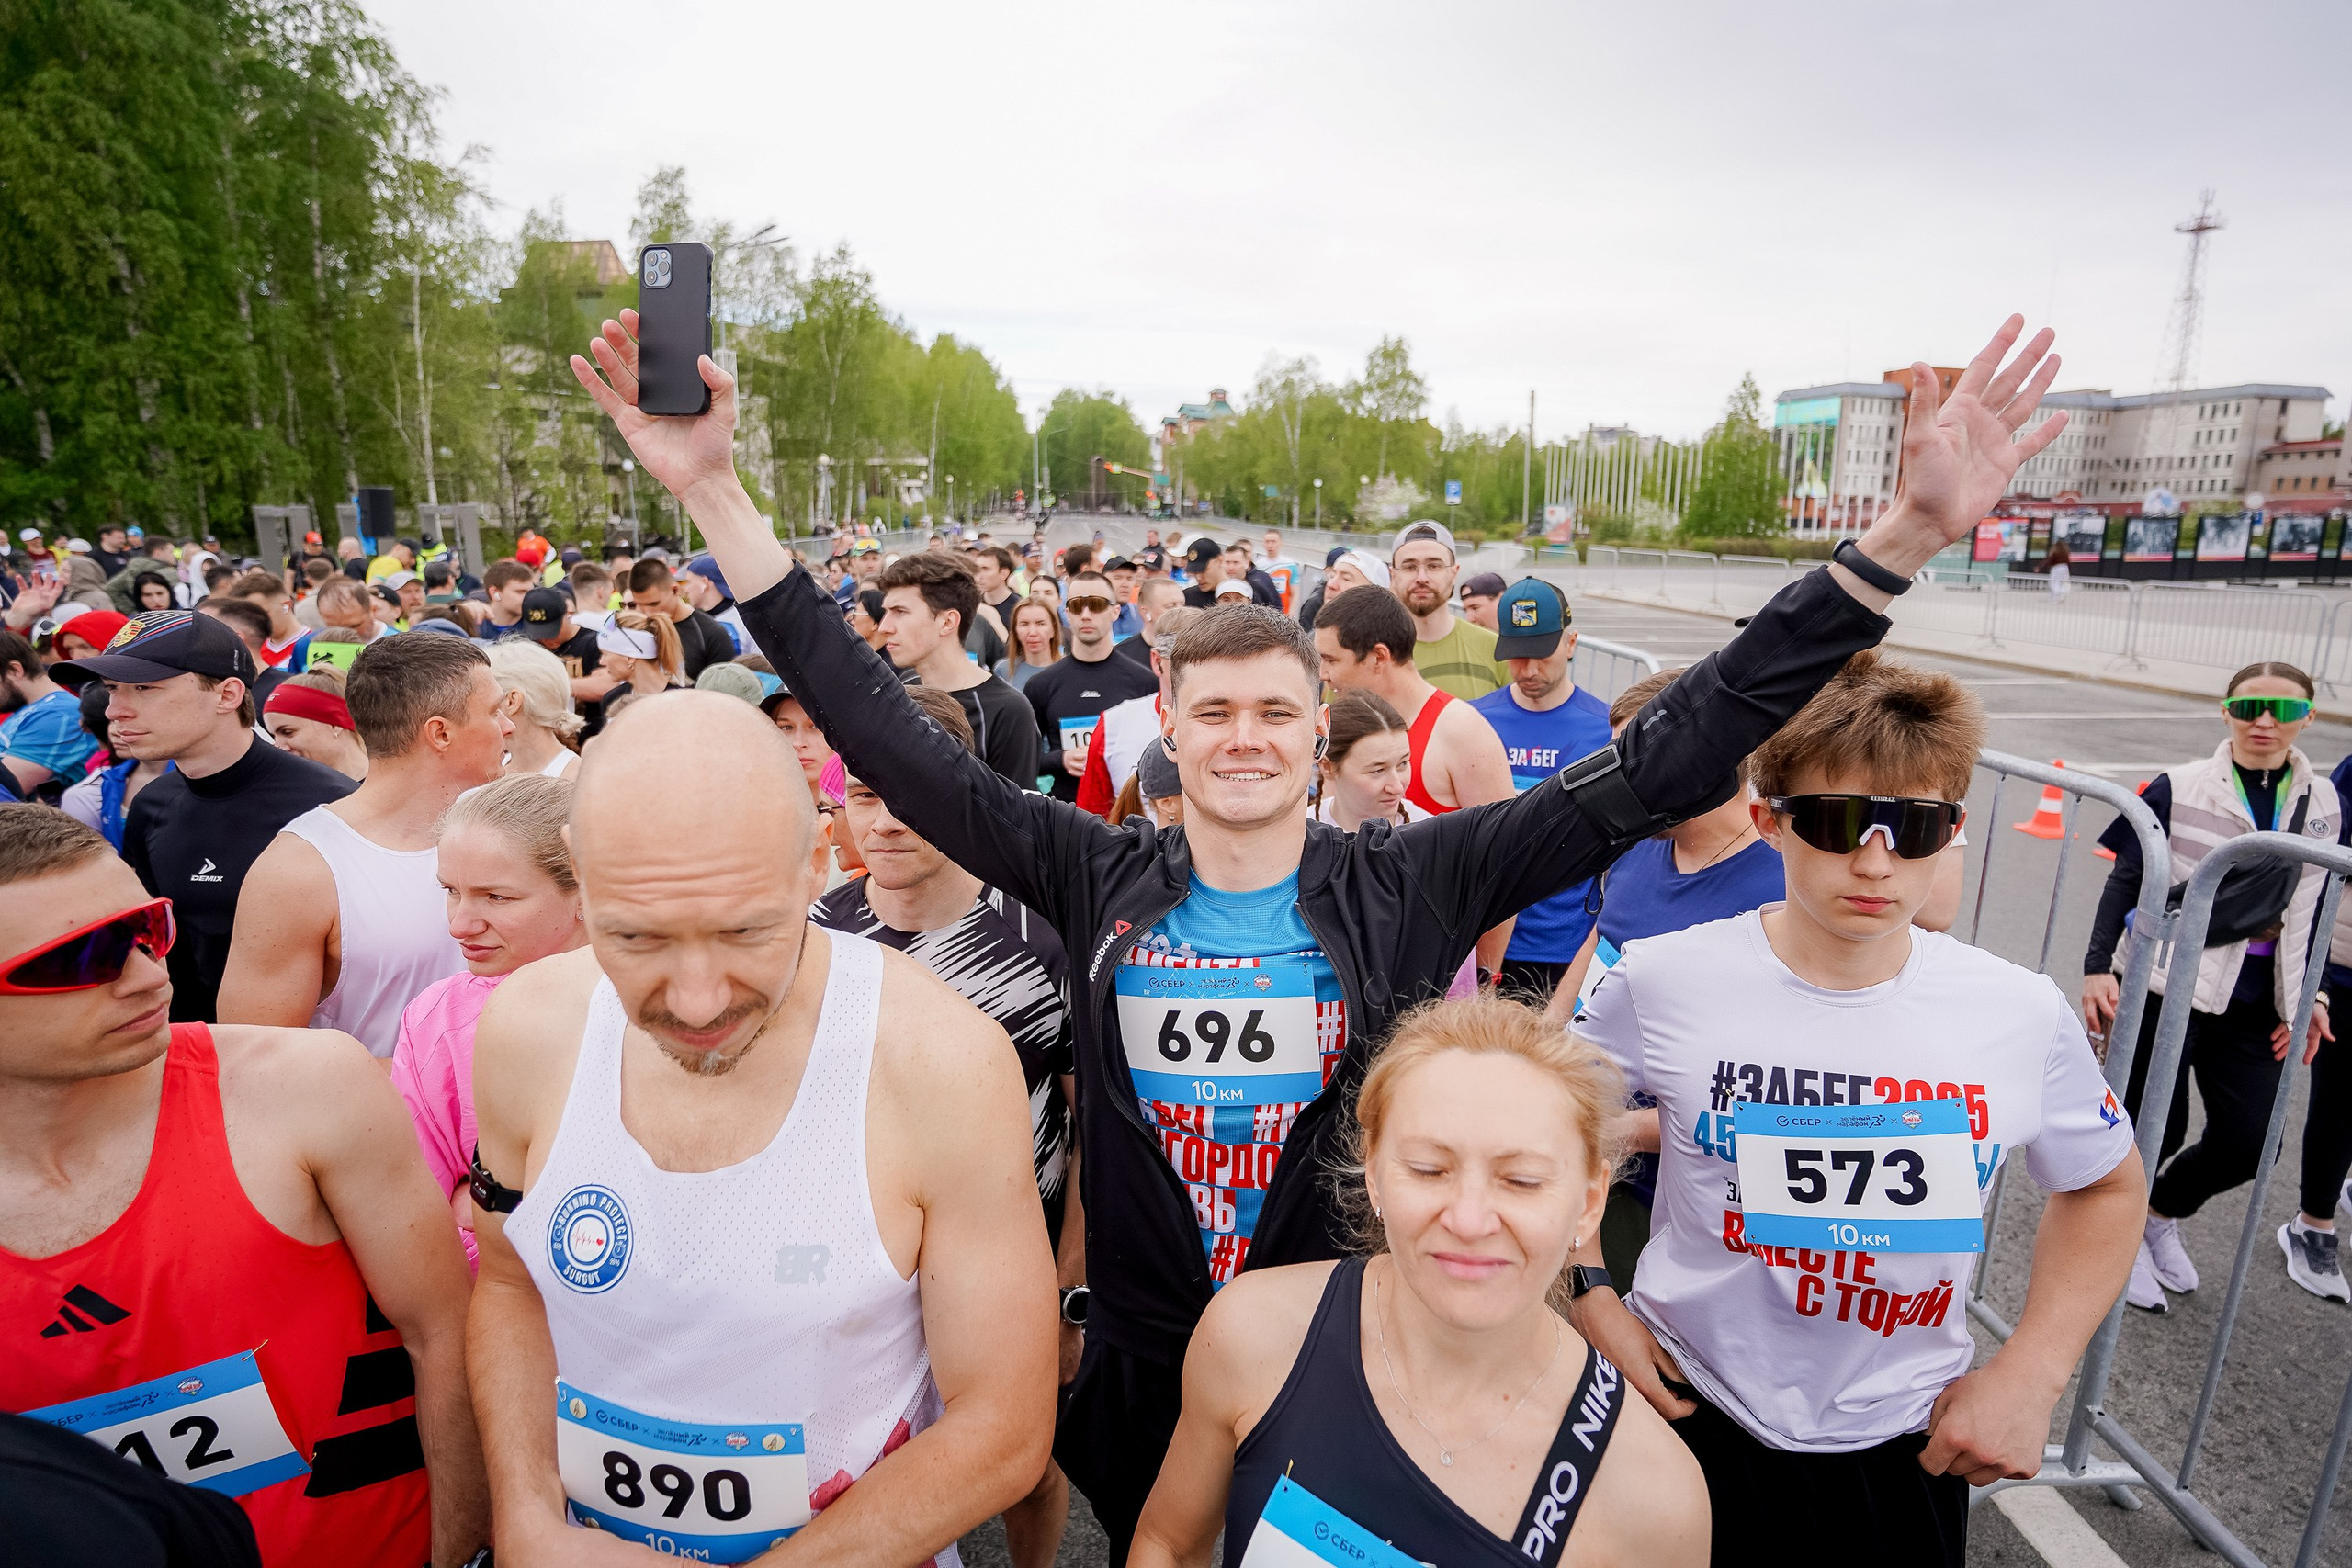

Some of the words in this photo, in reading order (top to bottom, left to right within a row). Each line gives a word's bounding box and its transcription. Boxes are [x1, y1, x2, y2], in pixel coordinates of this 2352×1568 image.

[1089, 931, 1118, 982] Reebok
[1158, 1010, 1275, 1063] 696
[1191, 1081, 1217, 1100] 10
[1792, 1118, 1822, 1126] СБЕР
[1784, 1149, 1928, 1206] 573
[557, 1193, 598, 1226] RUNNING
[599, 1196, 628, 1242] PROJECT
[1827, 1224, 1859, 1246] 10
[563, 1264, 601, 1286] SURGUT
[1796, 1274, 1826, 1317] С
[1835, 1280, 1954, 1337] ТОБОЙ
[610, 1416, 639, 1432] СБЕР
[1572, 1348, 1617, 1452] NIKE
[603, 1451, 752, 1522] 890
[1521, 1461, 1578, 1562] PRO
[645, 1533, 676, 1557] 10
[1331, 1533, 1365, 1561] СБЕР
